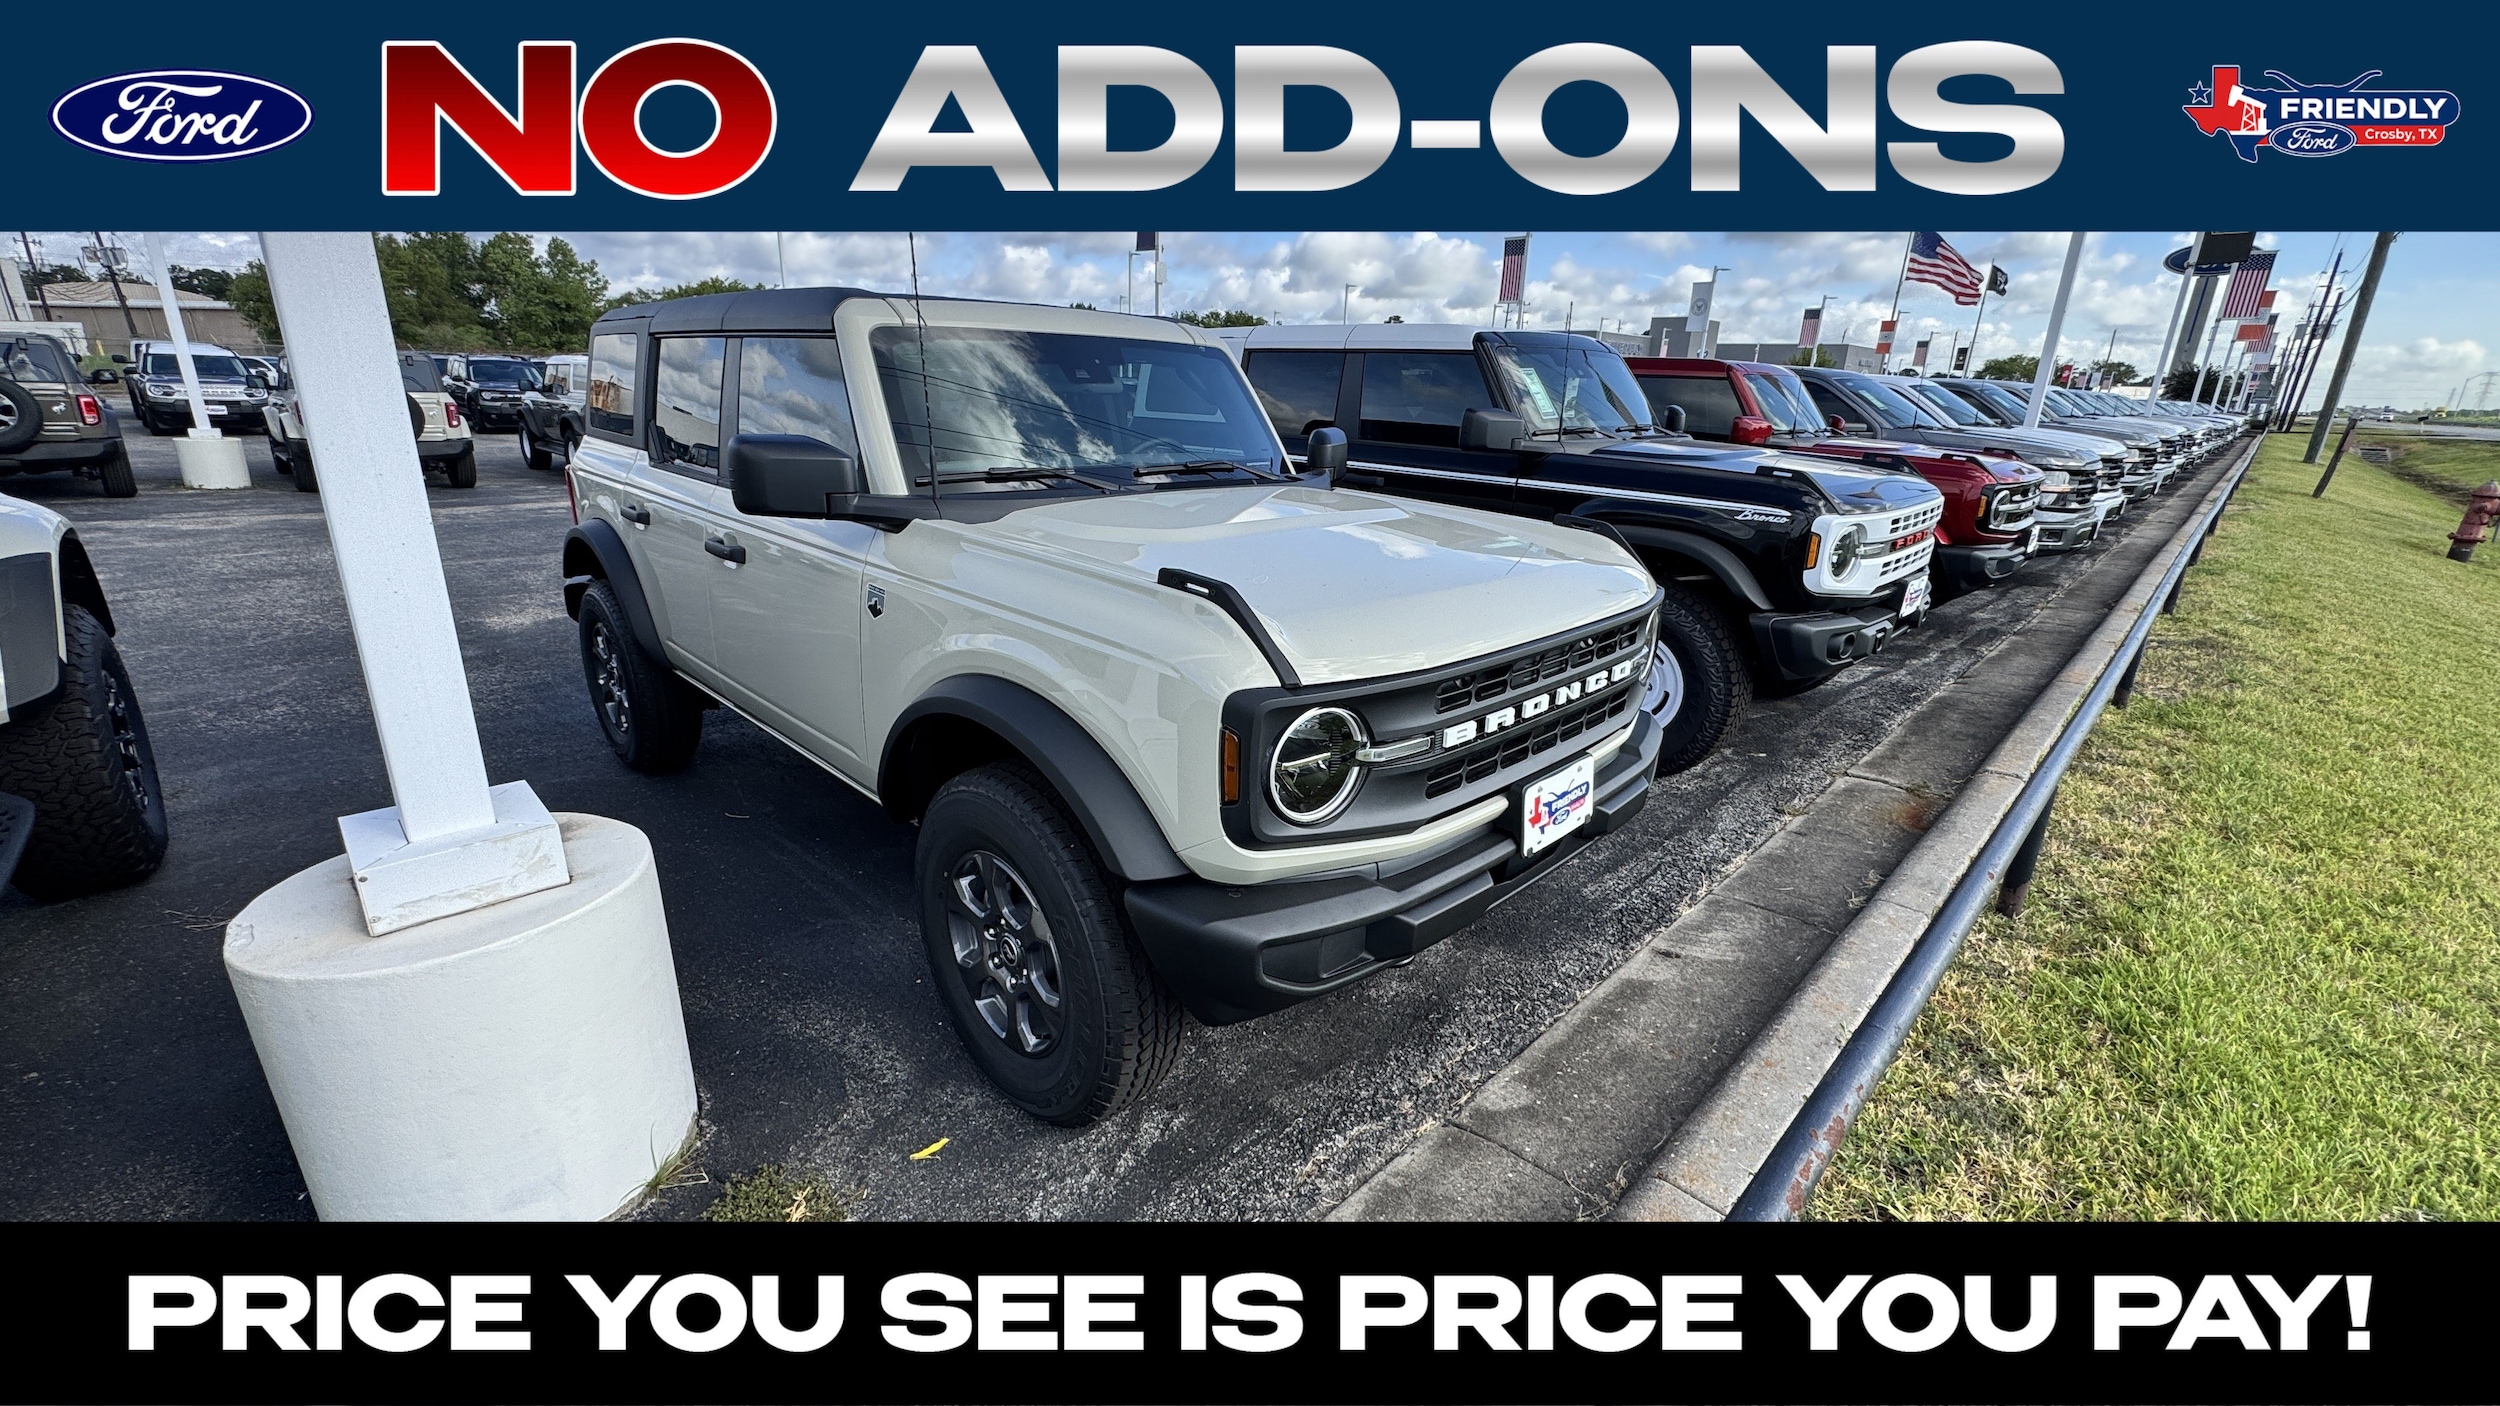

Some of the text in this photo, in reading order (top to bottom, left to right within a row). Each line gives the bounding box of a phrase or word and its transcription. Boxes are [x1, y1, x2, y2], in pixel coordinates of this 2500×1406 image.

[1734, 509, 1790, 524] Bronco
[1895, 530, 1930, 550] FORD
[1442, 661, 1633, 749] BRONCO
[1551, 784, 1588, 812] FRIENDLY
